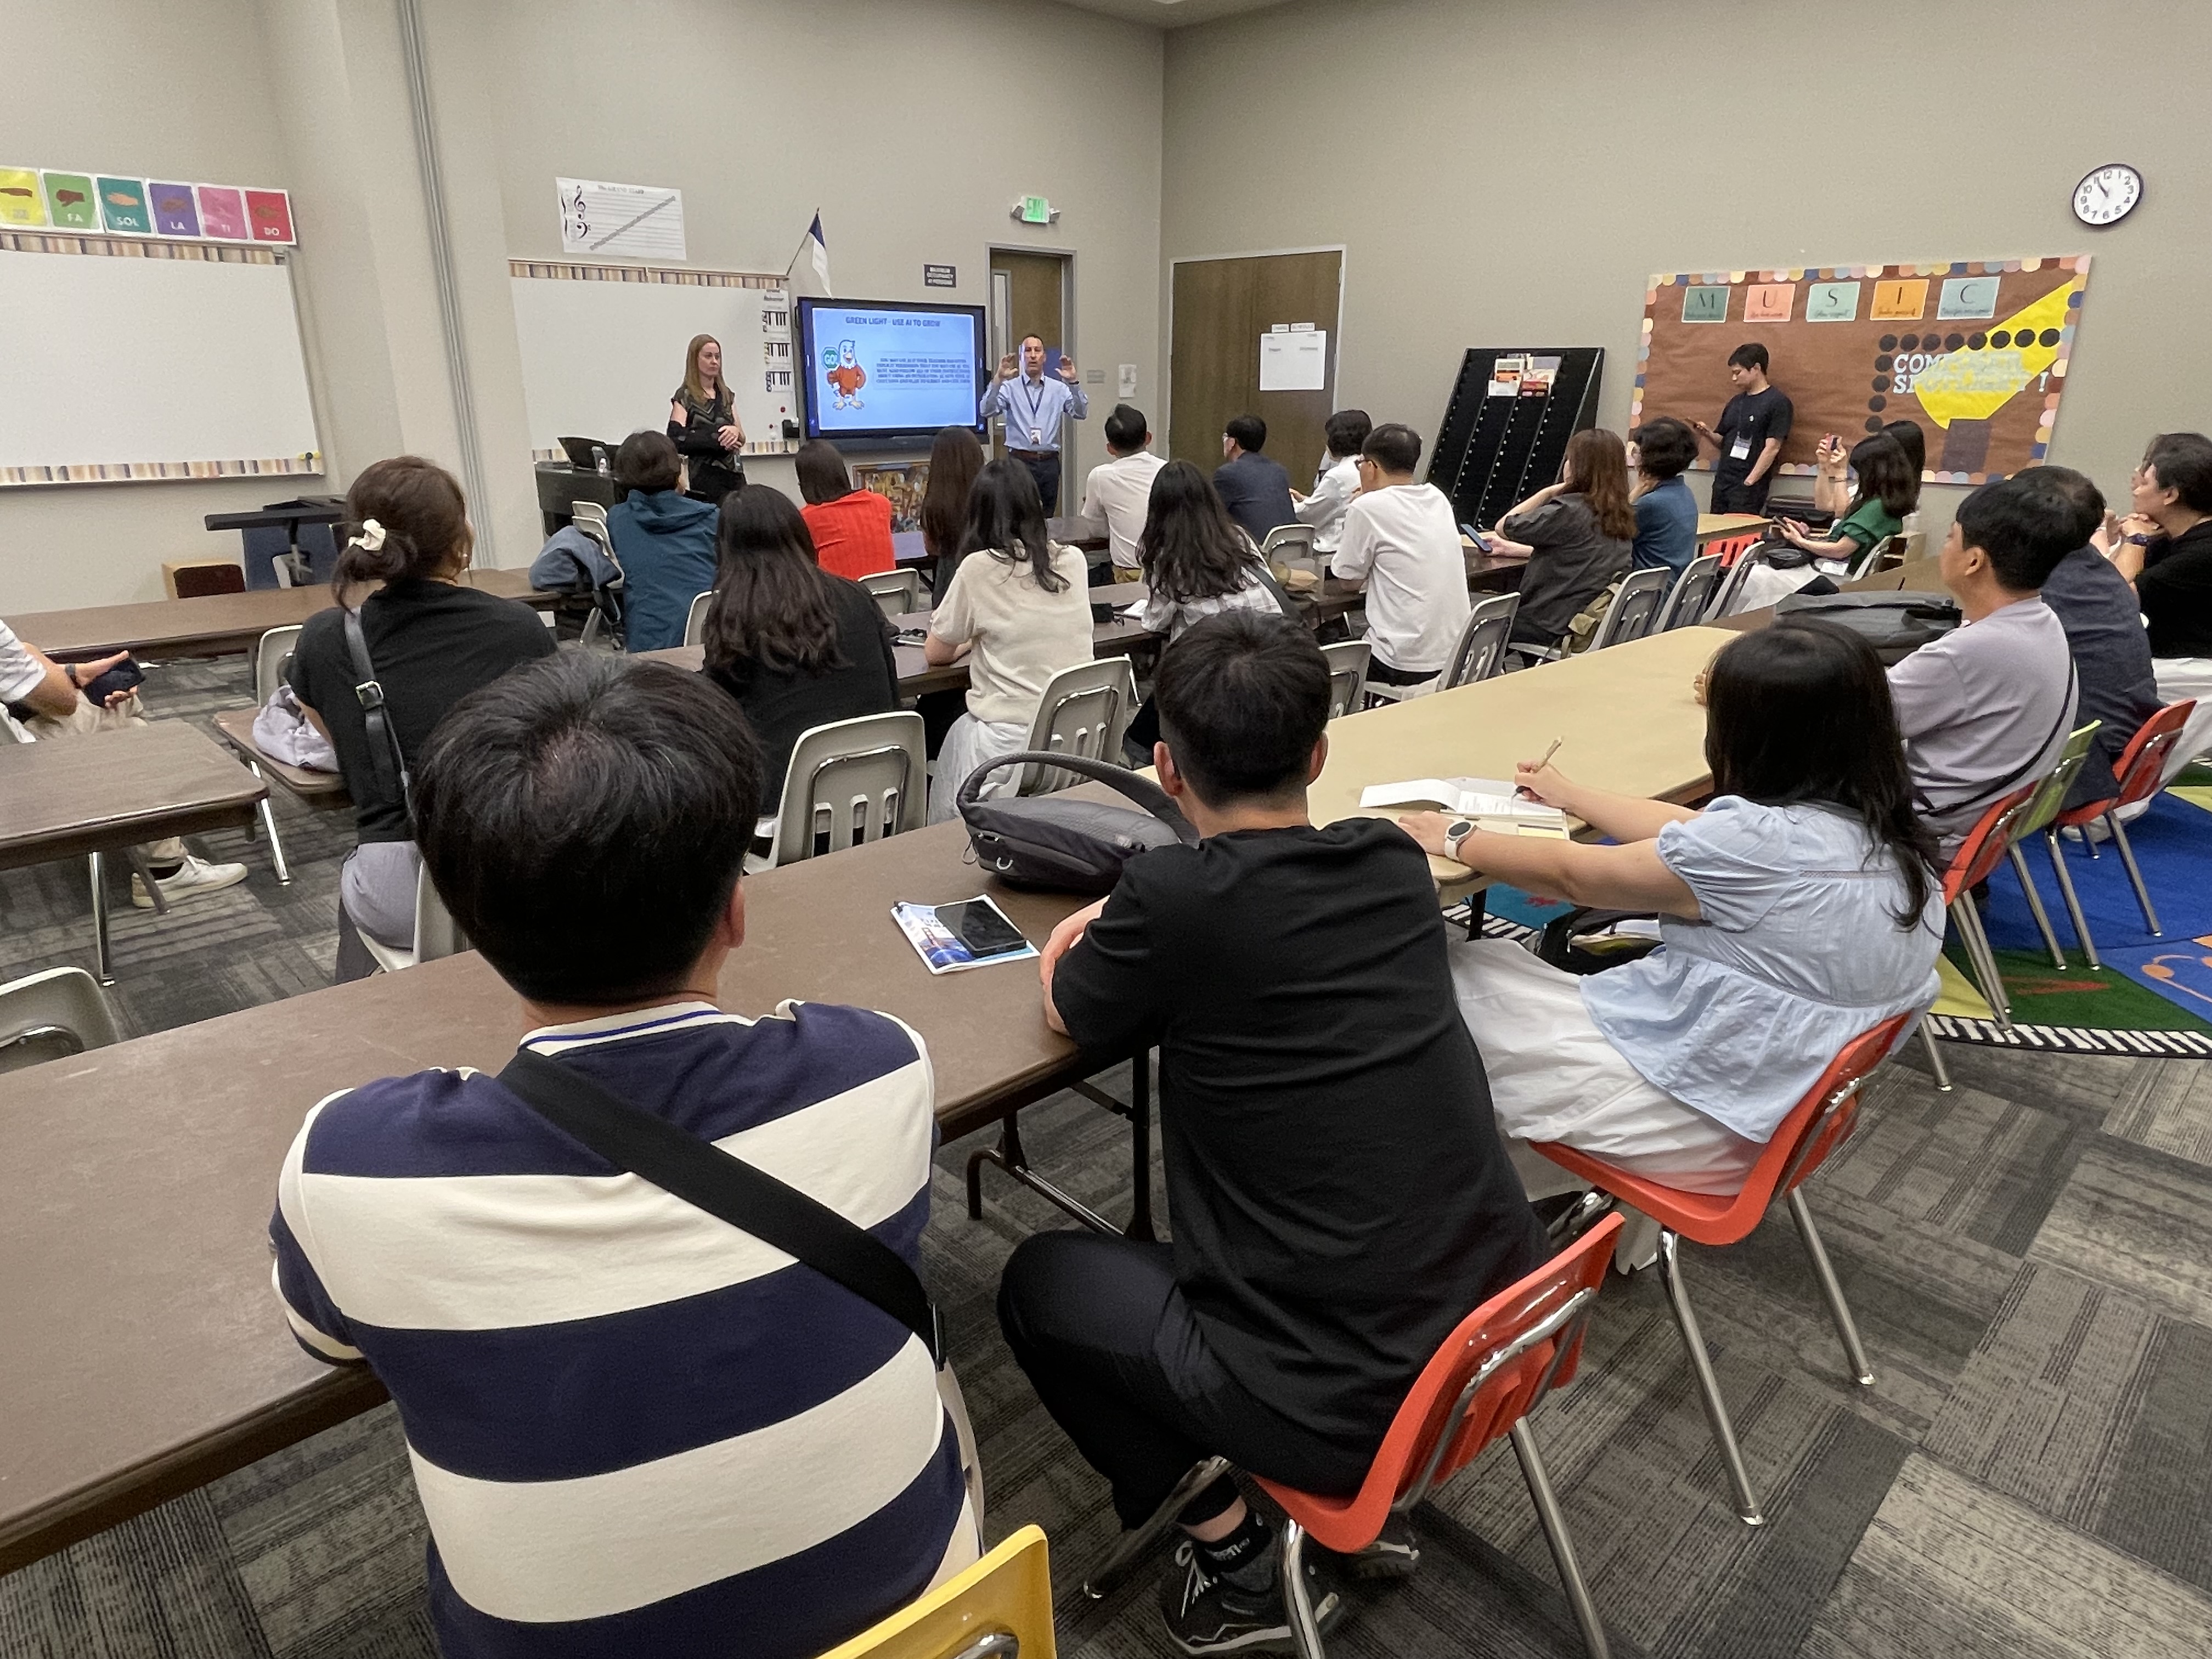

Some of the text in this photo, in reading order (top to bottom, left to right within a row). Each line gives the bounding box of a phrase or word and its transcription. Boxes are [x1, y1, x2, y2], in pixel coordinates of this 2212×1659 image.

[2103, 170, 2112, 179] 12
[2124, 176, 2131, 185] 2
[2084, 184, 2092, 194] 10
[2127, 184, 2134, 194] 3
[2080, 195, 2087, 204] 9
[2083, 204, 2090, 214] 8
[2114, 205, 2122, 215] 5
[2091, 210, 2098, 219] 7
[2102, 211, 2110, 219] 6
[67, 213, 280, 236] FA SOL LA TI DO
[1695, 283, 1979, 309] M U S I C
[845, 317, 867, 325] GREEN
